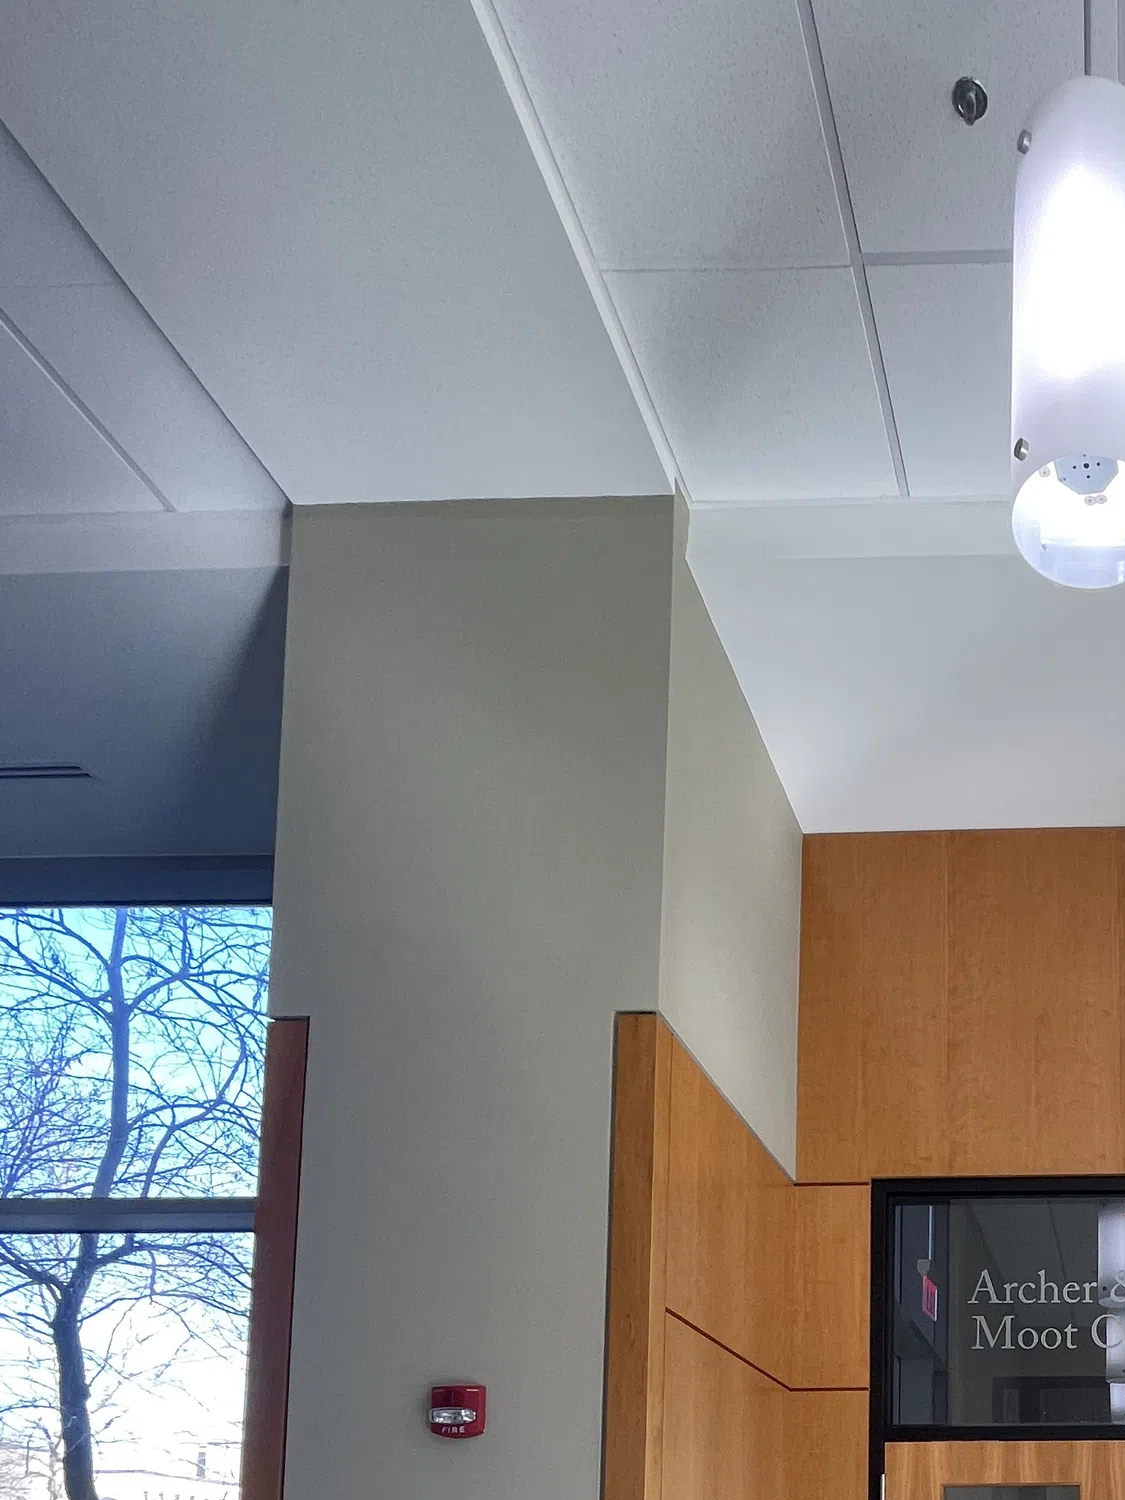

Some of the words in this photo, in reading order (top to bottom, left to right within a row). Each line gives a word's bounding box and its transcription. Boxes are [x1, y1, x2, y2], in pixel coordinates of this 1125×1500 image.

[967, 1268, 1098, 1305] Archer
[971, 1315, 1079, 1351] Moot
[441, 1426, 465, 1434] FIRE
